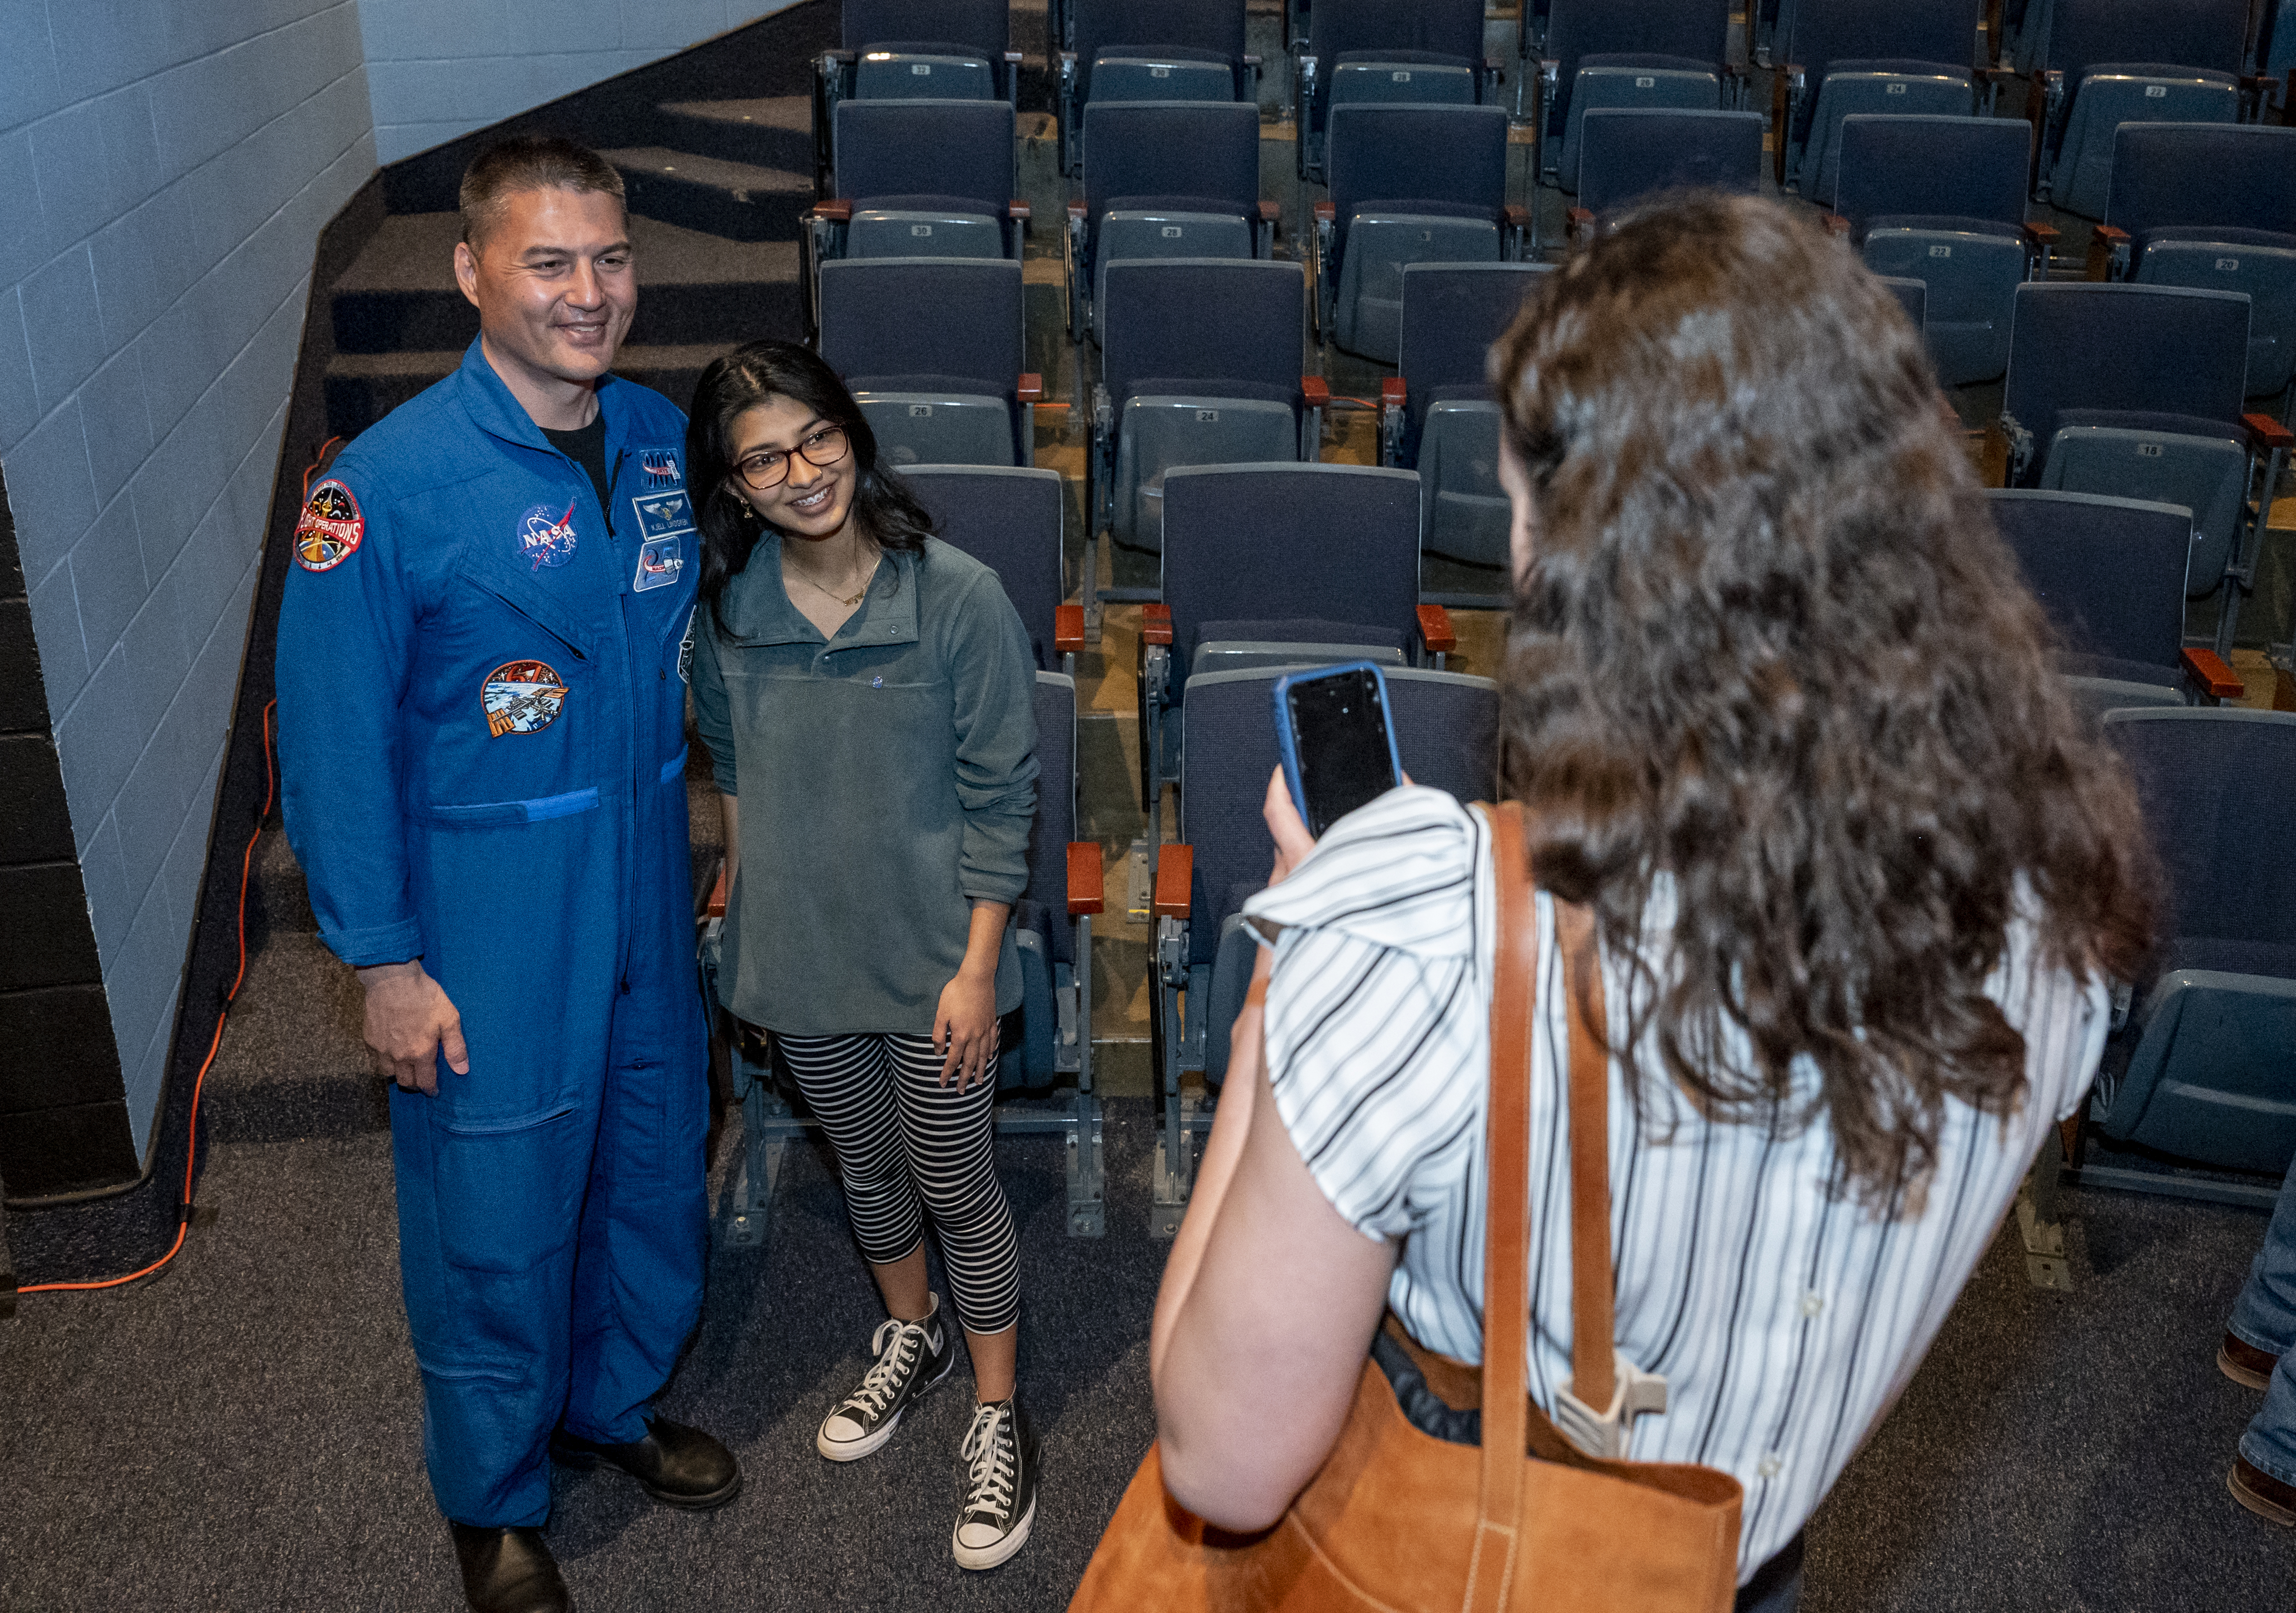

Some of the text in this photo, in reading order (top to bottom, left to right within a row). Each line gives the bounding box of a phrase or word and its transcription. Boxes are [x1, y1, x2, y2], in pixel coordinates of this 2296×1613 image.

[2221, 260, 2234, 269] 20
[915, 407, 927, 415] 26
[1201, 412, 1213, 420] 24
[2145, 446, 2158, 455] 18
[315, 518, 361, 545] OPERATIONS
[522, 524, 576, 548] NASA
